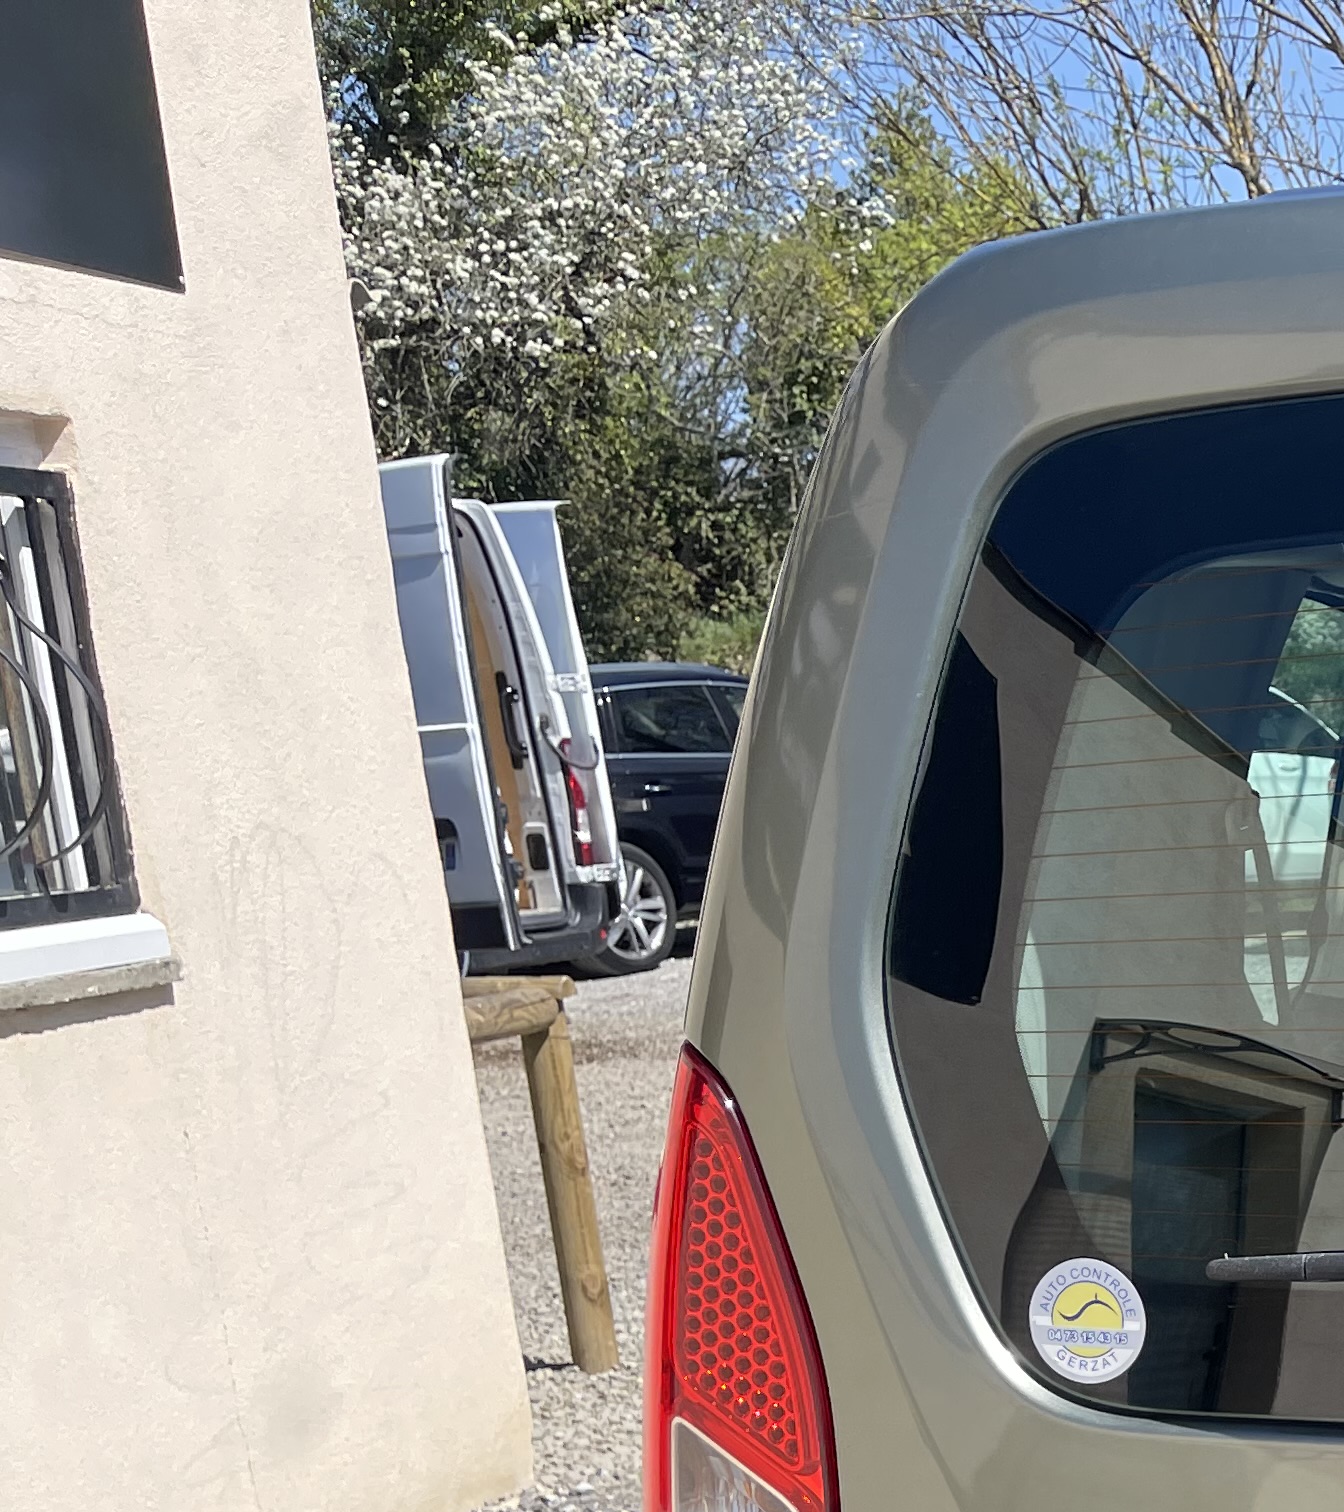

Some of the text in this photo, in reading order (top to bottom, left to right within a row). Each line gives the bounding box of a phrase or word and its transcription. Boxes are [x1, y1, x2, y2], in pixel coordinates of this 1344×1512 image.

[1039, 1266, 1137, 1319] AUTO CONTROLE
[1047, 1329, 1063, 1342] 04
[1056, 1348, 1119, 1372] GERZAT
